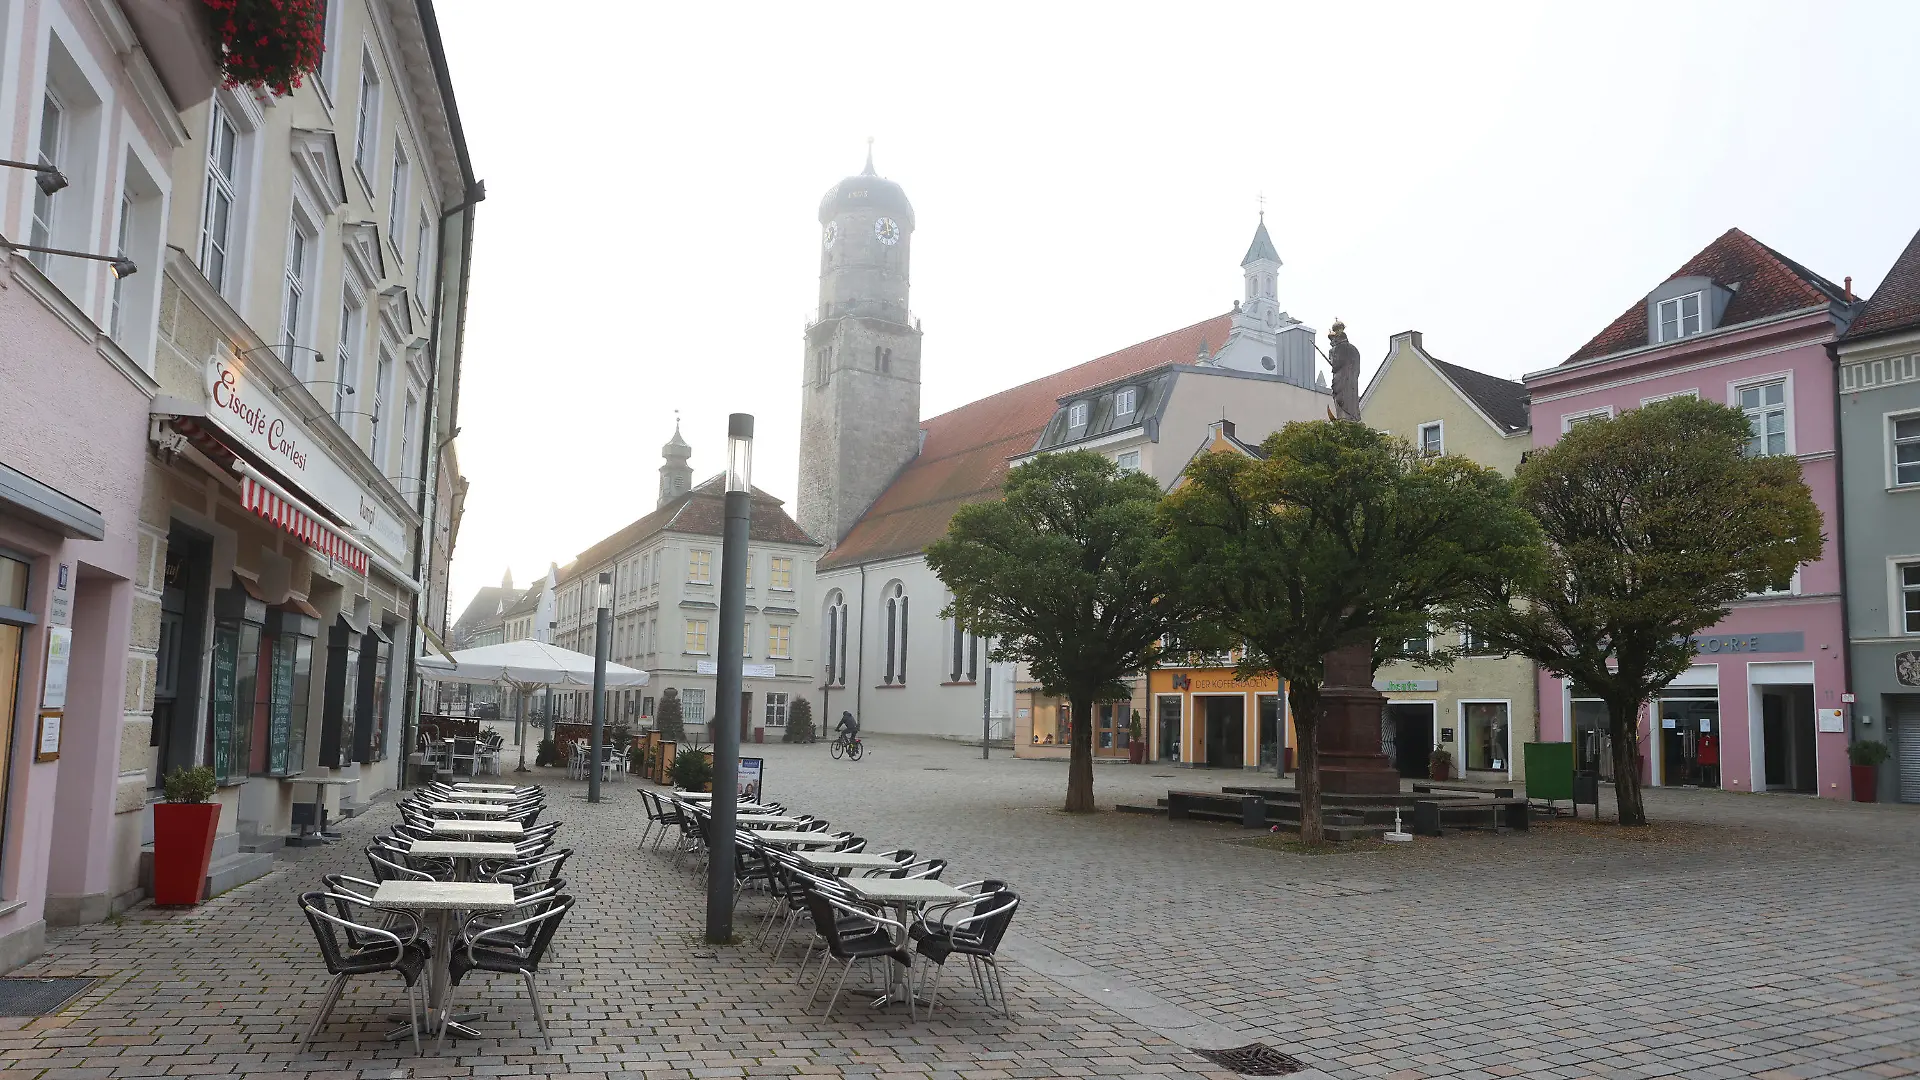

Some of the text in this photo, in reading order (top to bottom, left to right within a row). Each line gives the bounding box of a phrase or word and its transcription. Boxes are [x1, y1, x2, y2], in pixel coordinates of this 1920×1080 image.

[213, 362, 307, 471] Eiscafé Carlesi
[1195, 680, 1211, 689] DER
